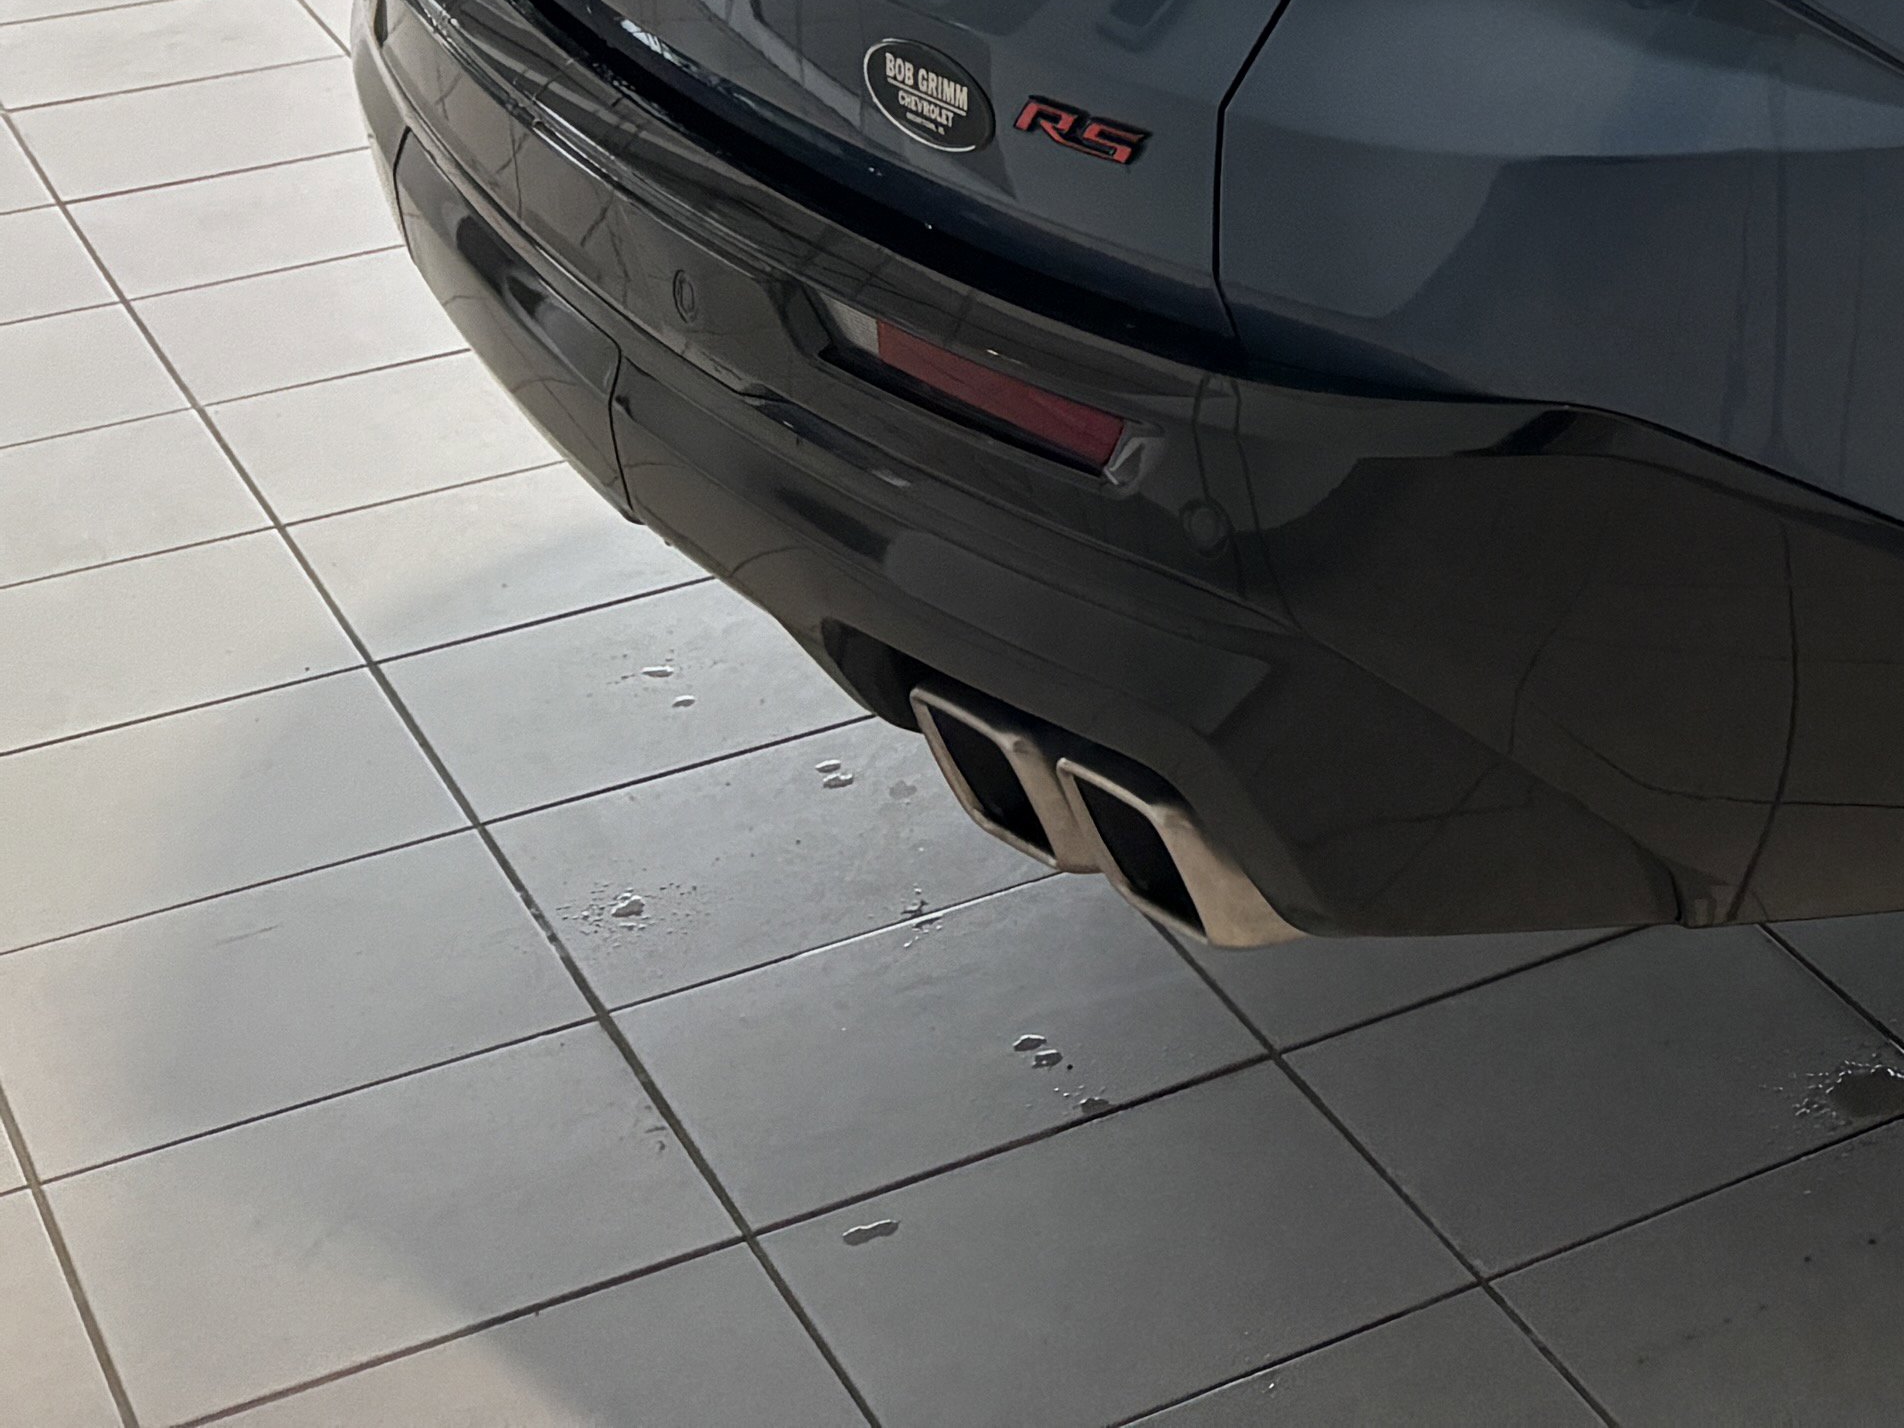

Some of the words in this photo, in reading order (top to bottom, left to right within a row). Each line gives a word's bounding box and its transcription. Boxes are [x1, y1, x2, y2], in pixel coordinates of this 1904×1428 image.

[885, 52, 915, 86] BOB
[918, 67, 969, 111] GRIMM
[898, 90, 956, 128] CHEVROLET
[1014, 99, 1145, 164] RS
